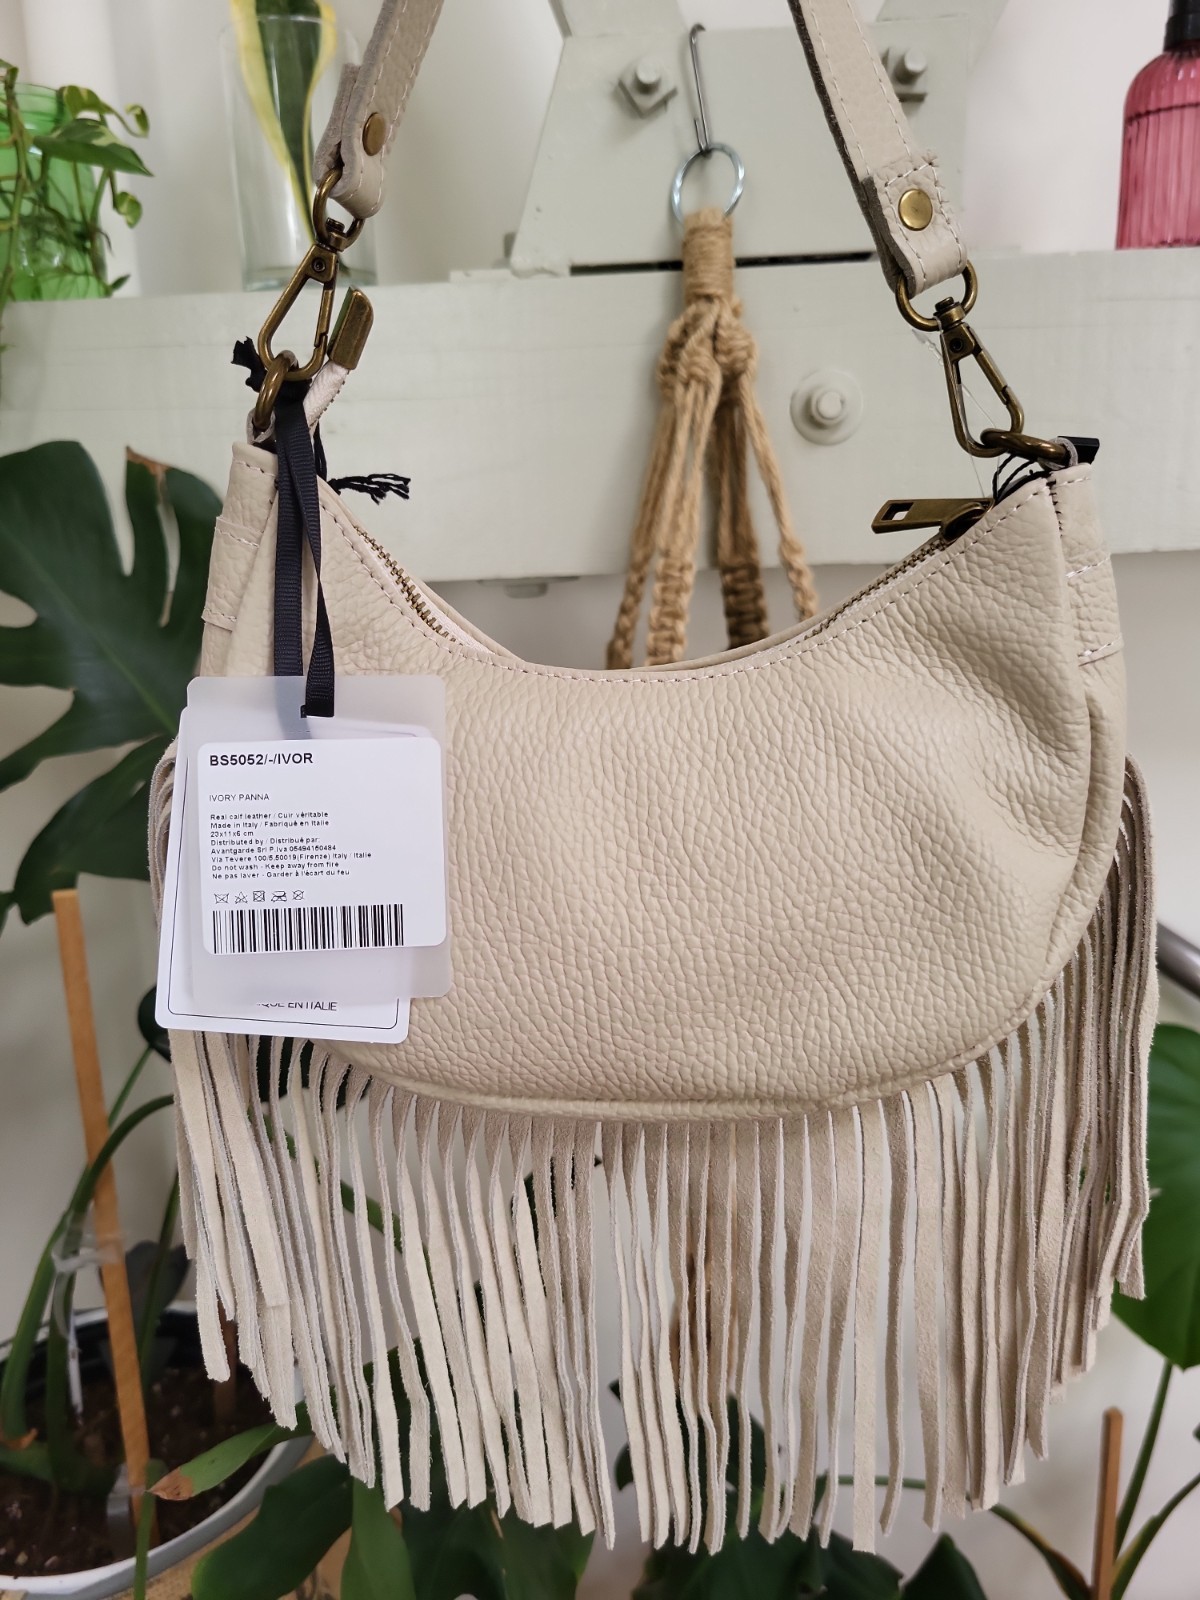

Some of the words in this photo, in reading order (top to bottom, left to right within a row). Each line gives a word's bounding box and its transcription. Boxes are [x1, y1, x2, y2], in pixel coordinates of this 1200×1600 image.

[210, 753, 313, 766] BS5052/-/IVOR
[209, 794, 236, 802] IVORY
[239, 793, 270, 801] PANNA
